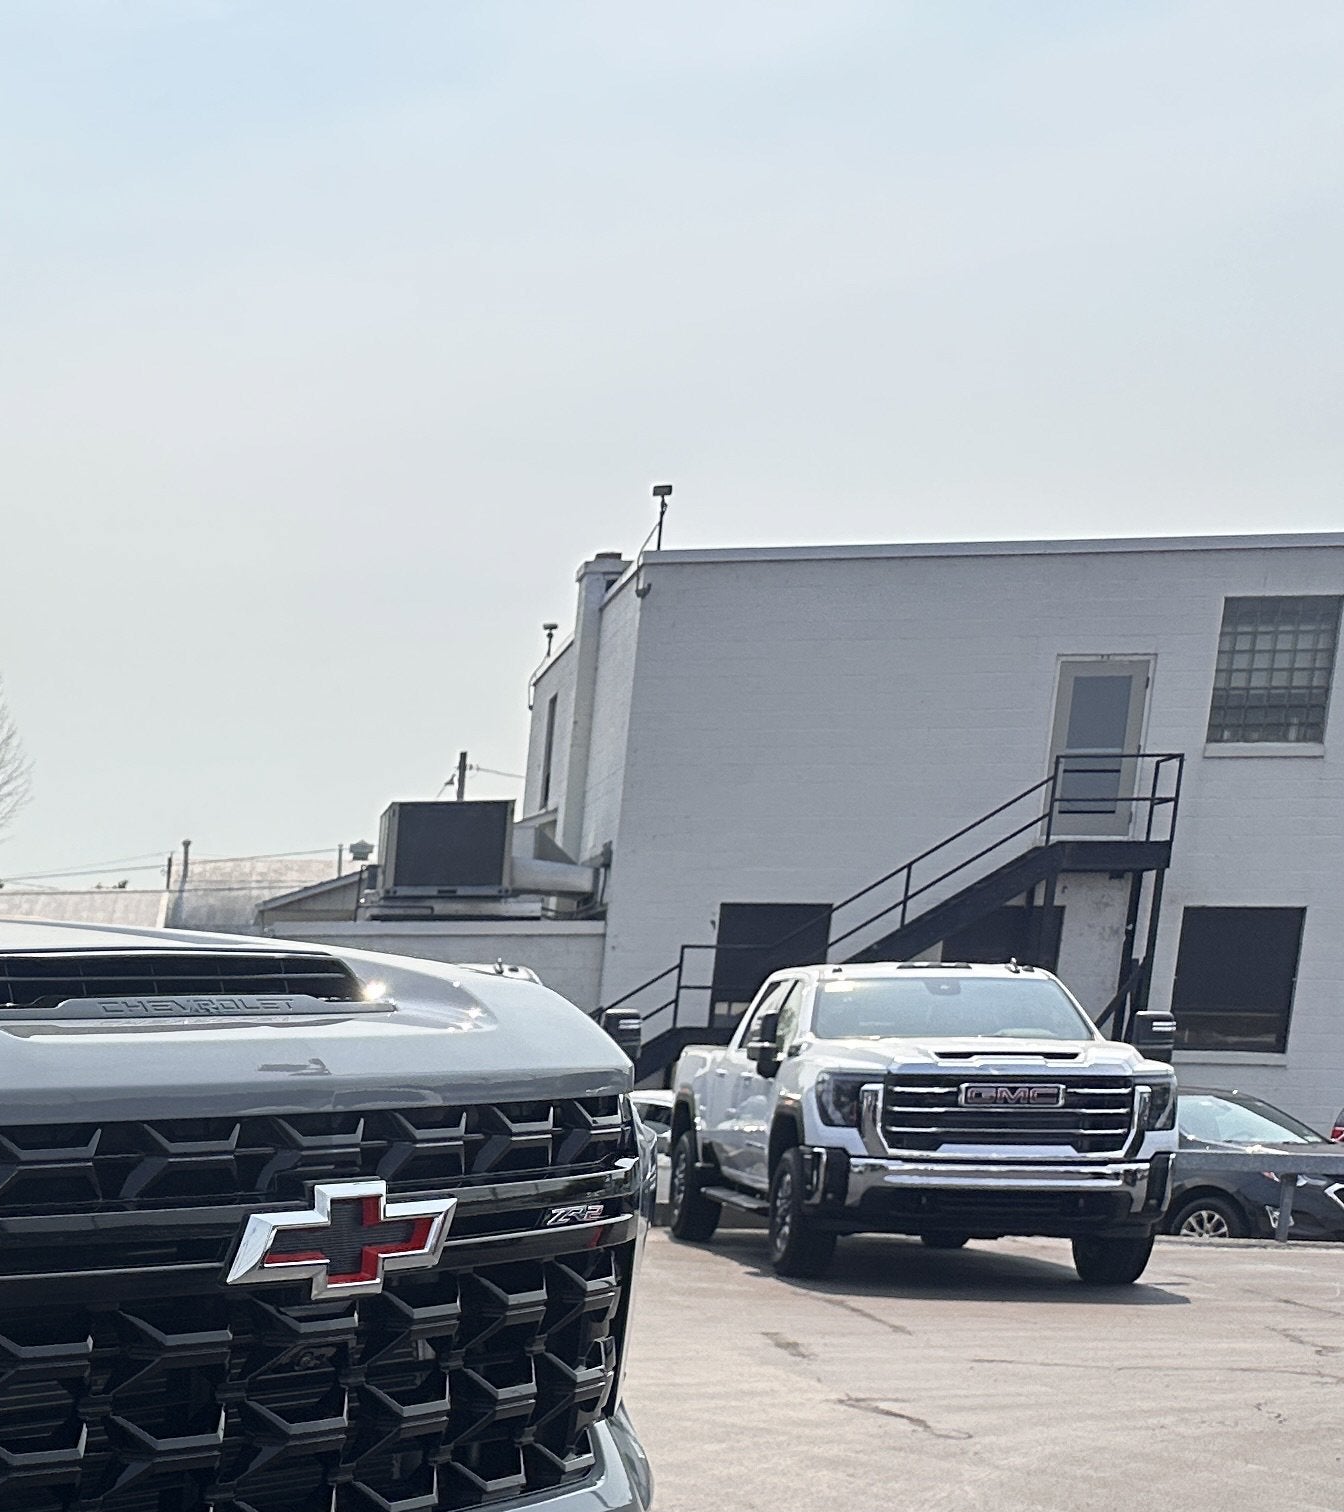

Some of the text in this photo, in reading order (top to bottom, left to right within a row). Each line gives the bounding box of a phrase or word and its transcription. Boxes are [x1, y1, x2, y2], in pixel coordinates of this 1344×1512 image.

[97, 998, 294, 1014] CHEVROLET
[966, 1087, 1059, 1103] GMC
[546, 1204, 604, 1226] ZR2
